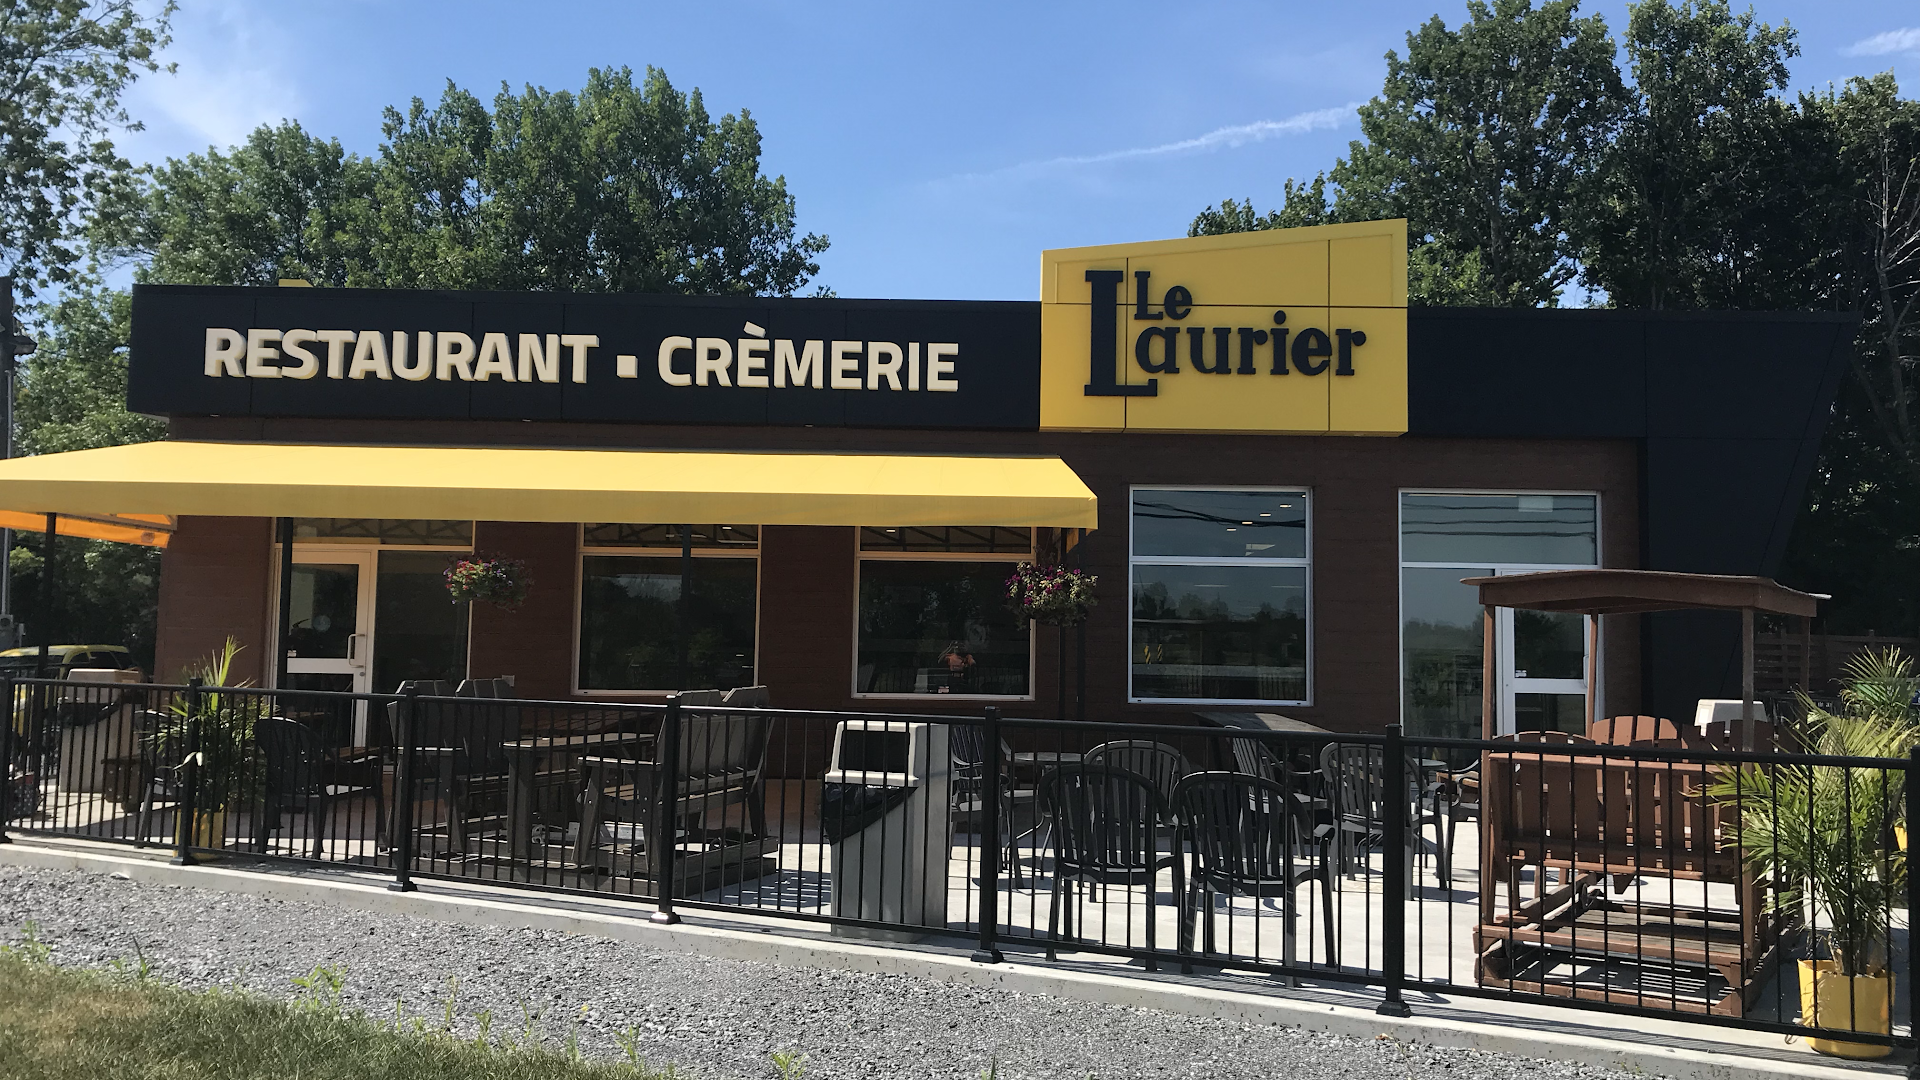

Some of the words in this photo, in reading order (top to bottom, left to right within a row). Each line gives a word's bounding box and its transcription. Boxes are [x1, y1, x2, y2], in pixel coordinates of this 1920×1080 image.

[1134, 270, 1193, 320] Le
[205, 328, 599, 383] RESTAURANT
[658, 322, 959, 392] CRÈMERIE
[1084, 270, 1367, 397] Laurier
